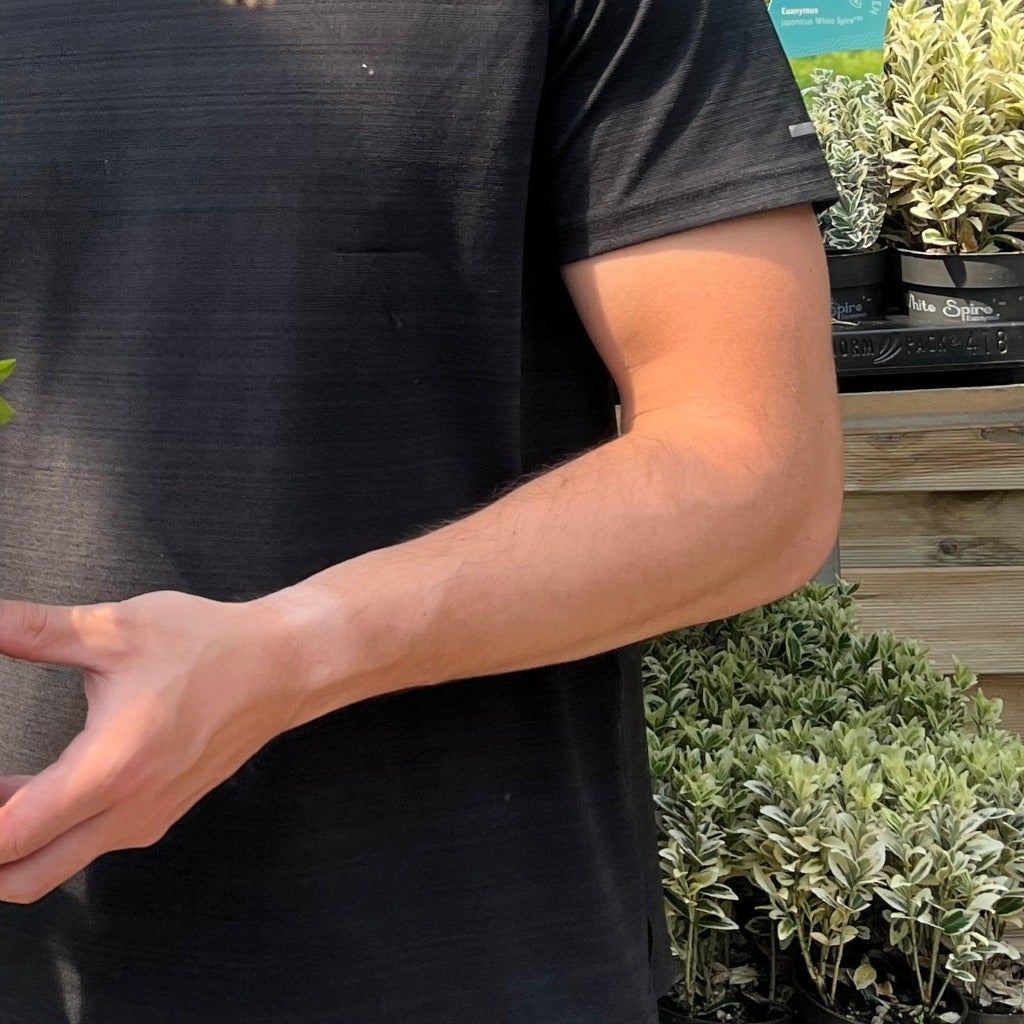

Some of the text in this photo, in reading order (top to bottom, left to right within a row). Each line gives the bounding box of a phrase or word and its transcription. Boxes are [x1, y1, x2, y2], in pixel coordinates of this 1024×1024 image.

[781, 7, 819, 16] Euonymus
[835, 336, 874, 357] ORM
[967, 330, 1008, 355] 418
